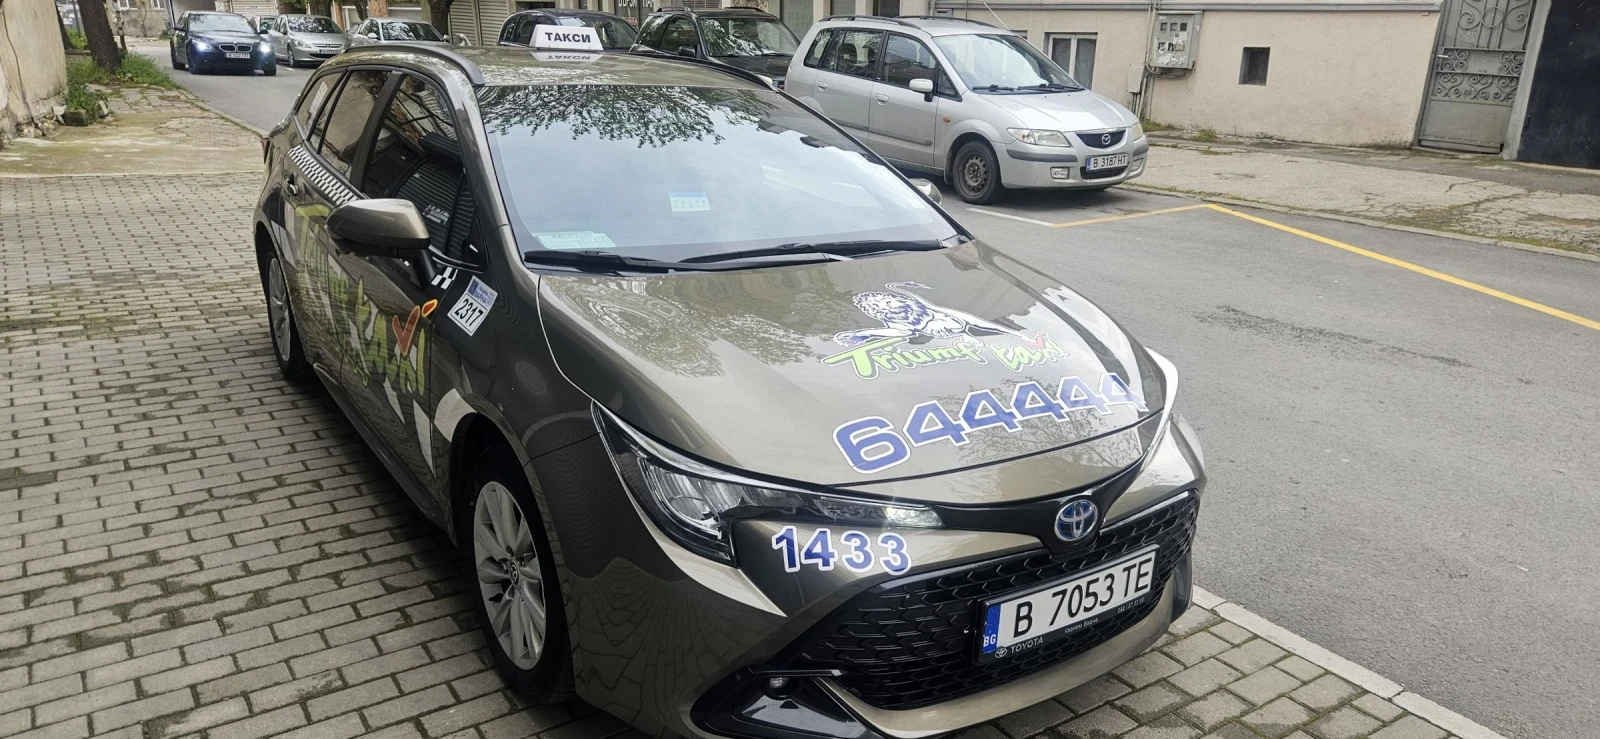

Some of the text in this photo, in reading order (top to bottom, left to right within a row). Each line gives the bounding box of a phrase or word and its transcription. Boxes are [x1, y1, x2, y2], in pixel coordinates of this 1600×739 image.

[545, 32, 591, 43] ТАКСИ
[1093, 155, 1127, 168] B 3187 HT
[454, 298, 484, 327] 2317
[821, 336, 988, 379] Triumf
[832, 372, 1149, 474] 644444
[772, 526, 912, 575] 1433
[1013, 557, 1152, 638] B 7053 TE
[983, 634, 997, 648] BG
[1010, 636, 1044, 654] TOYOTA
